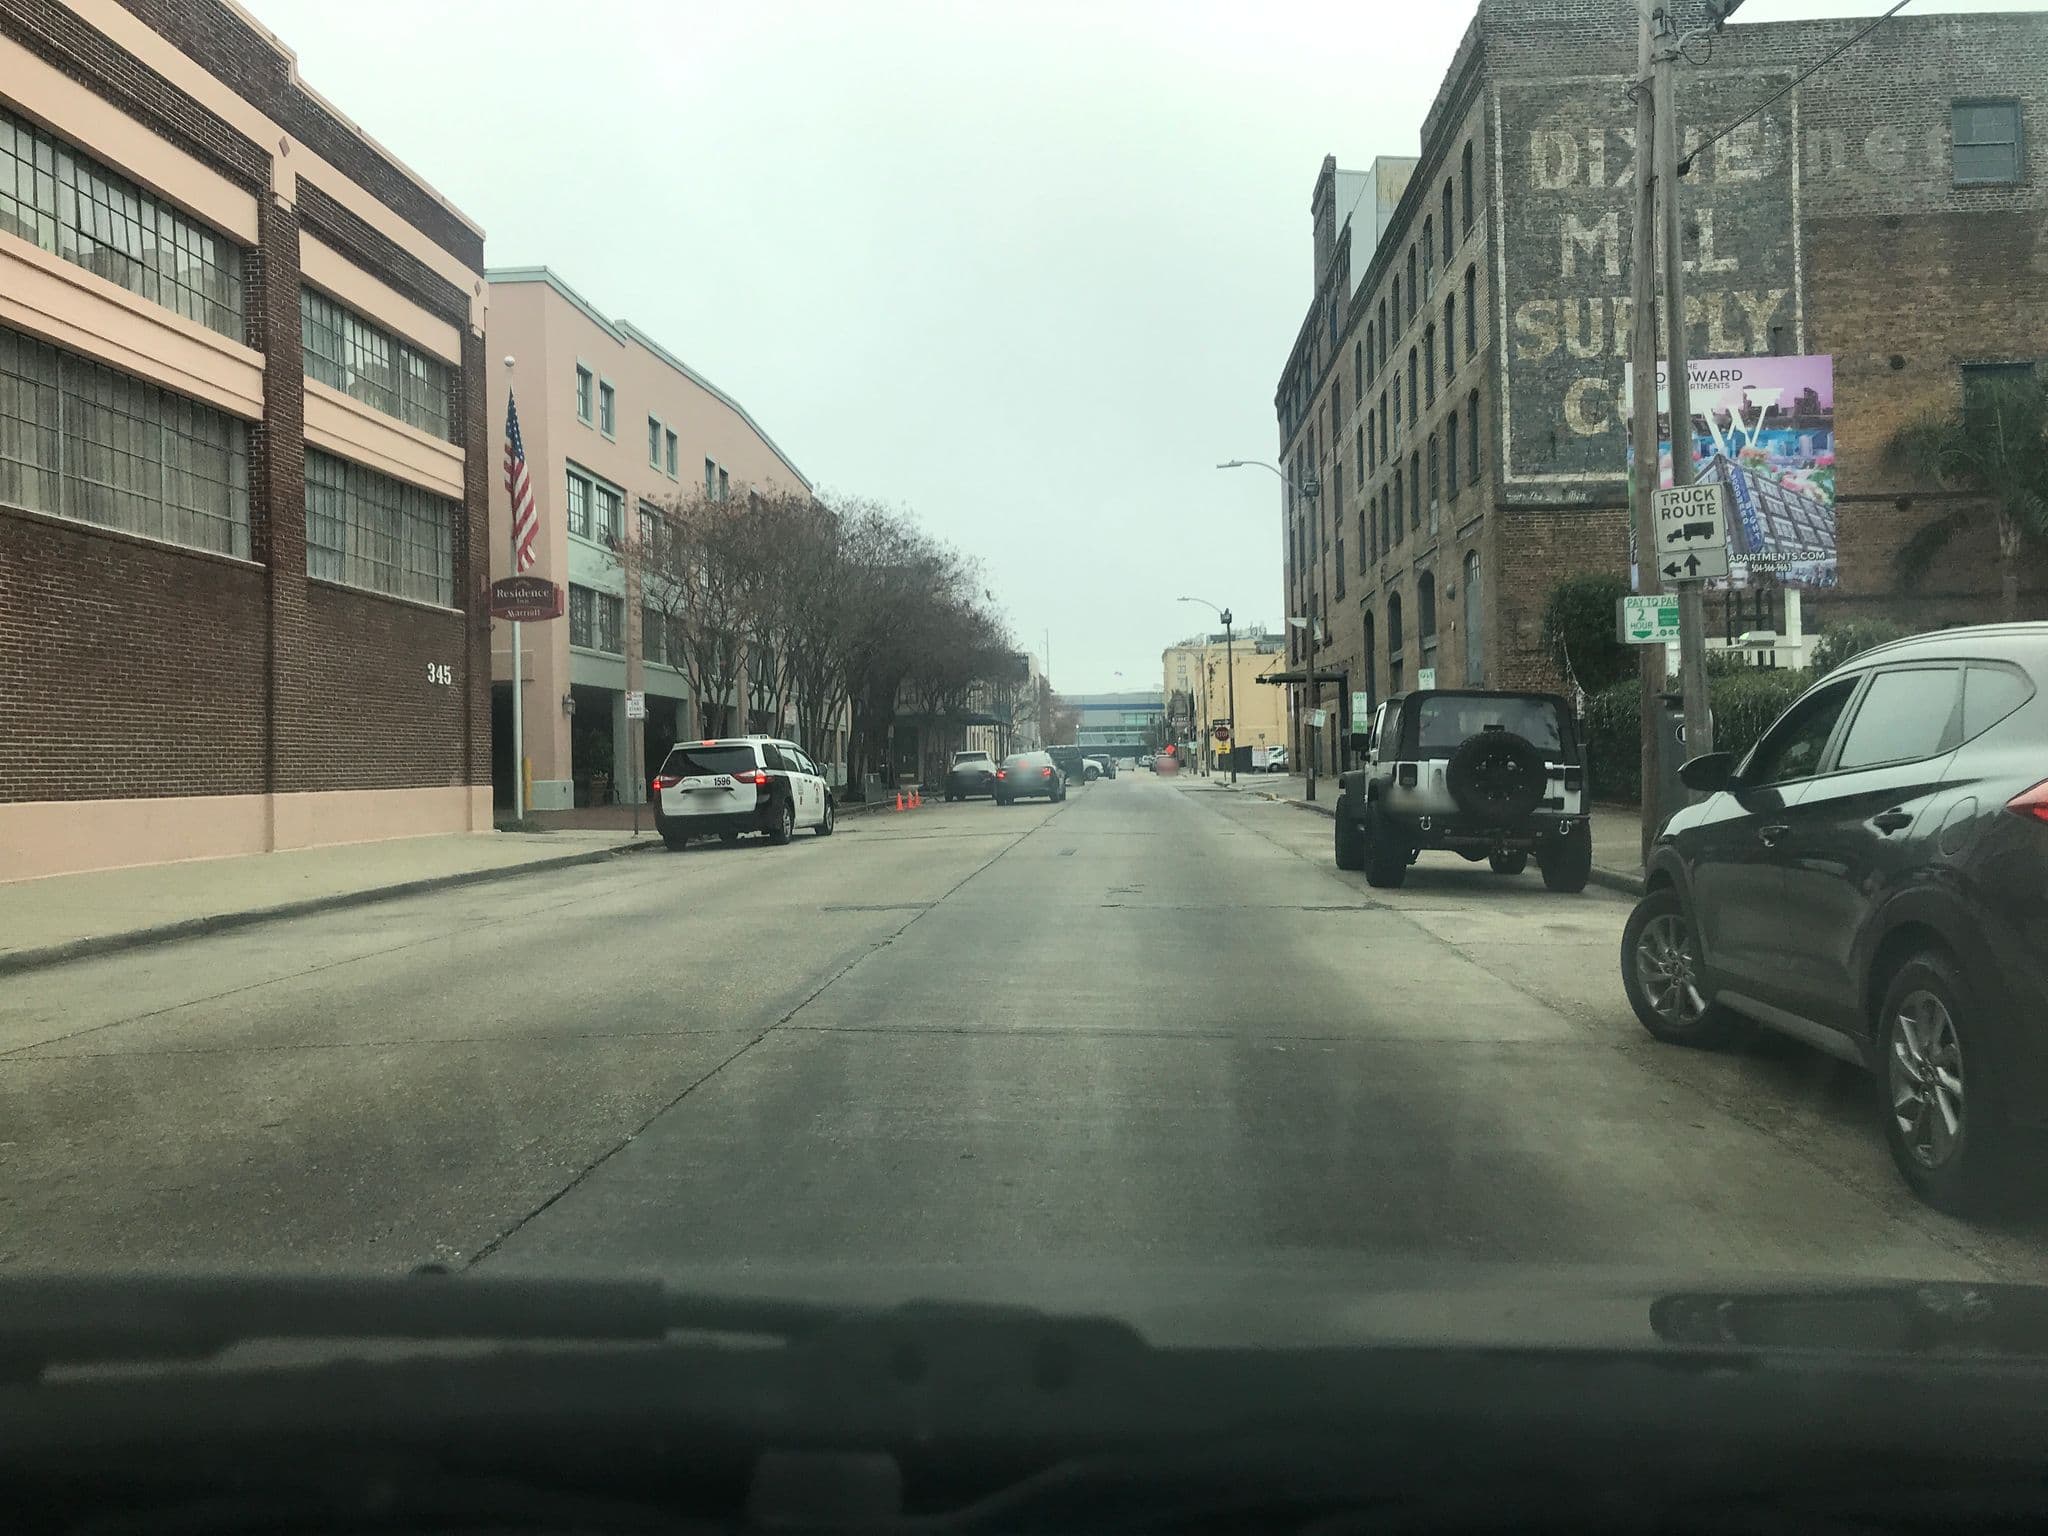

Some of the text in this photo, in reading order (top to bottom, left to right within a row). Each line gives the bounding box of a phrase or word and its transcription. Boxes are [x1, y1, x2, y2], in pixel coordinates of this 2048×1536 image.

[1559, 208, 1739, 278] MLL
[1655, 369, 1743, 384] OWARD
[1690, 382, 1730, 391] RTMENTS
[1564, 377, 1627, 434] C
[1660, 488, 1716, 506] TRUCK
[1661, 503, 1717, 521] ROUTE
[496, 588, 550, 599] Residence
[1627, 596, 1679, 608] PAY TO PAR
[1637, 608, 1646, 621] 2
[1630, 621, 1654, 630] HOUR
[427, 662, 452, 685] 345
[713, 776, 731, 787] 1596
